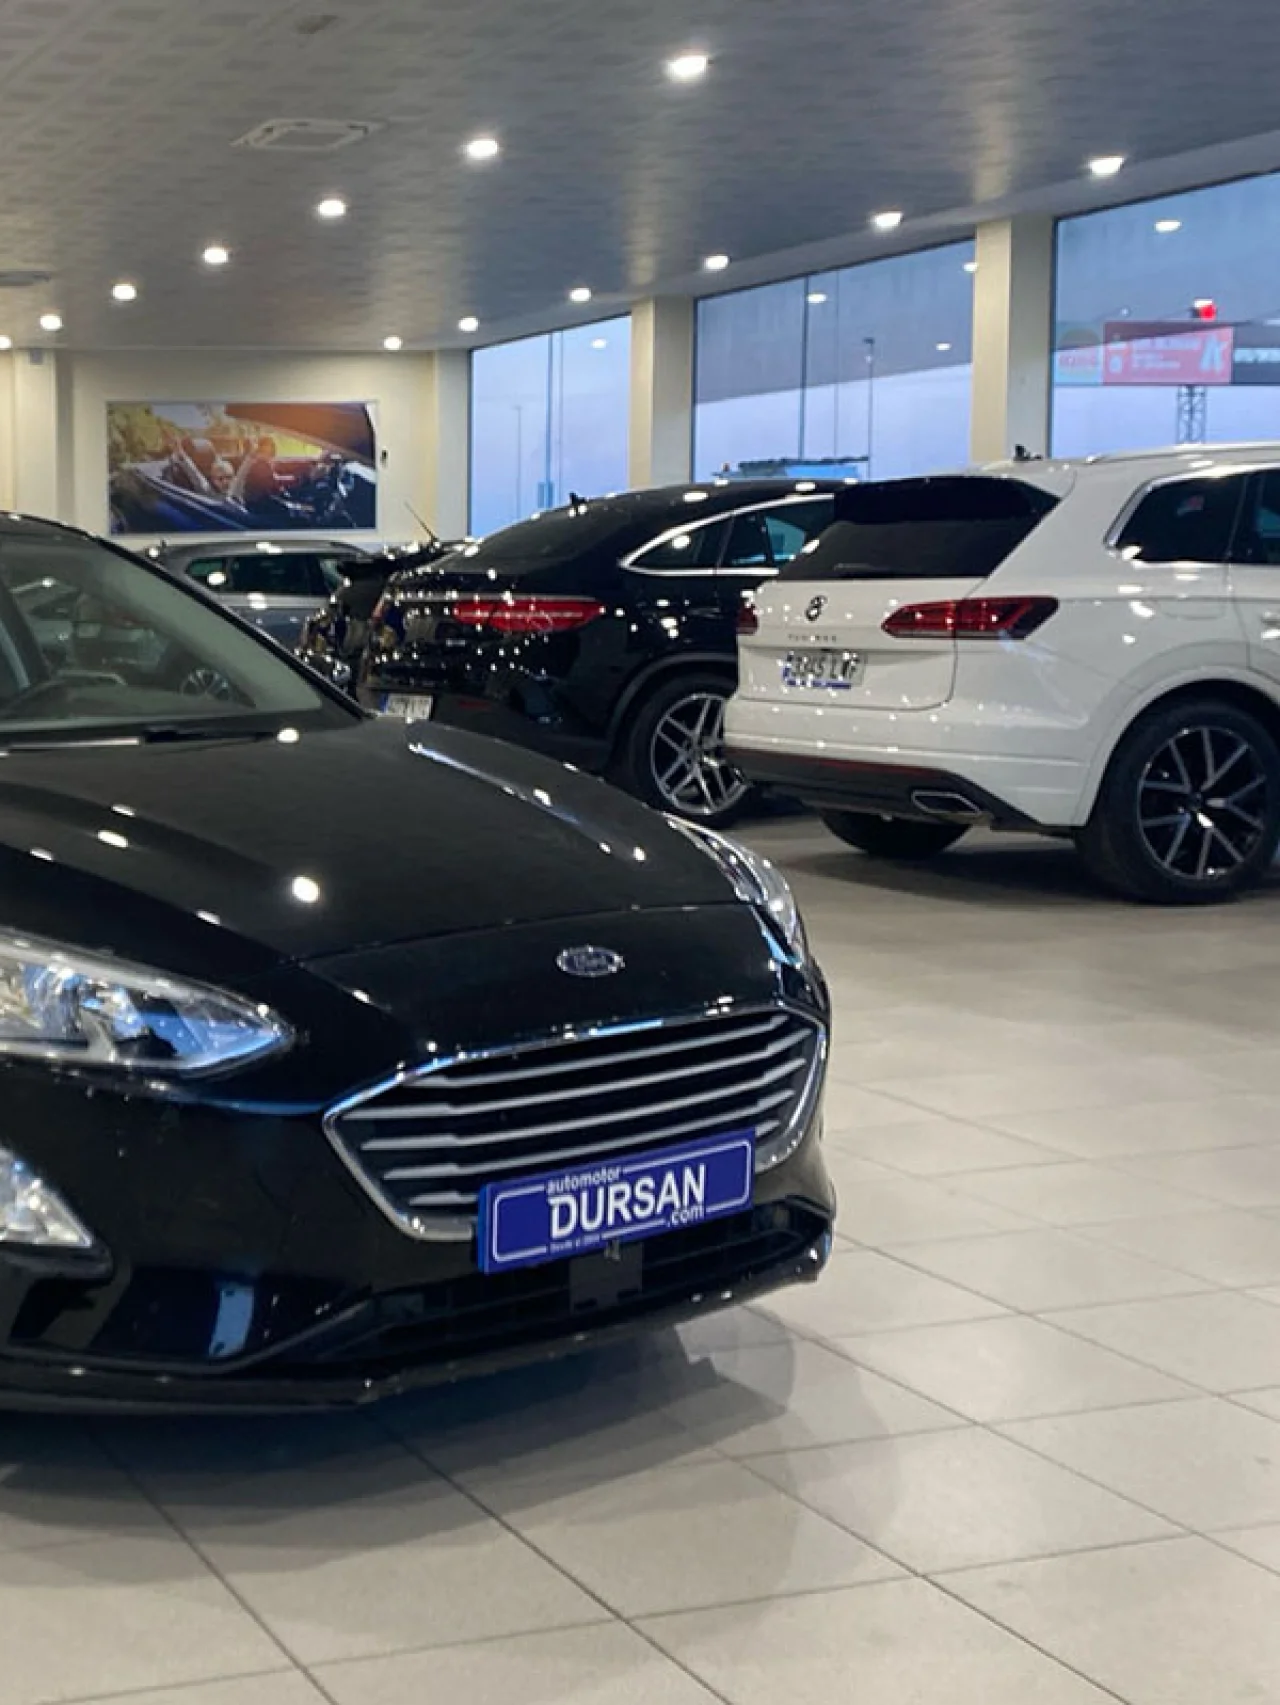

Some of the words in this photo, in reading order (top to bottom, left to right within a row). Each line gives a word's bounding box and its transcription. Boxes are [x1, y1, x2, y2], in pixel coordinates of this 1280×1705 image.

[546, 1166, 621, 1193] automotor
[548, 1163, 707, 1239] DURSAN
[667, 1204, 706, 1228] .com
